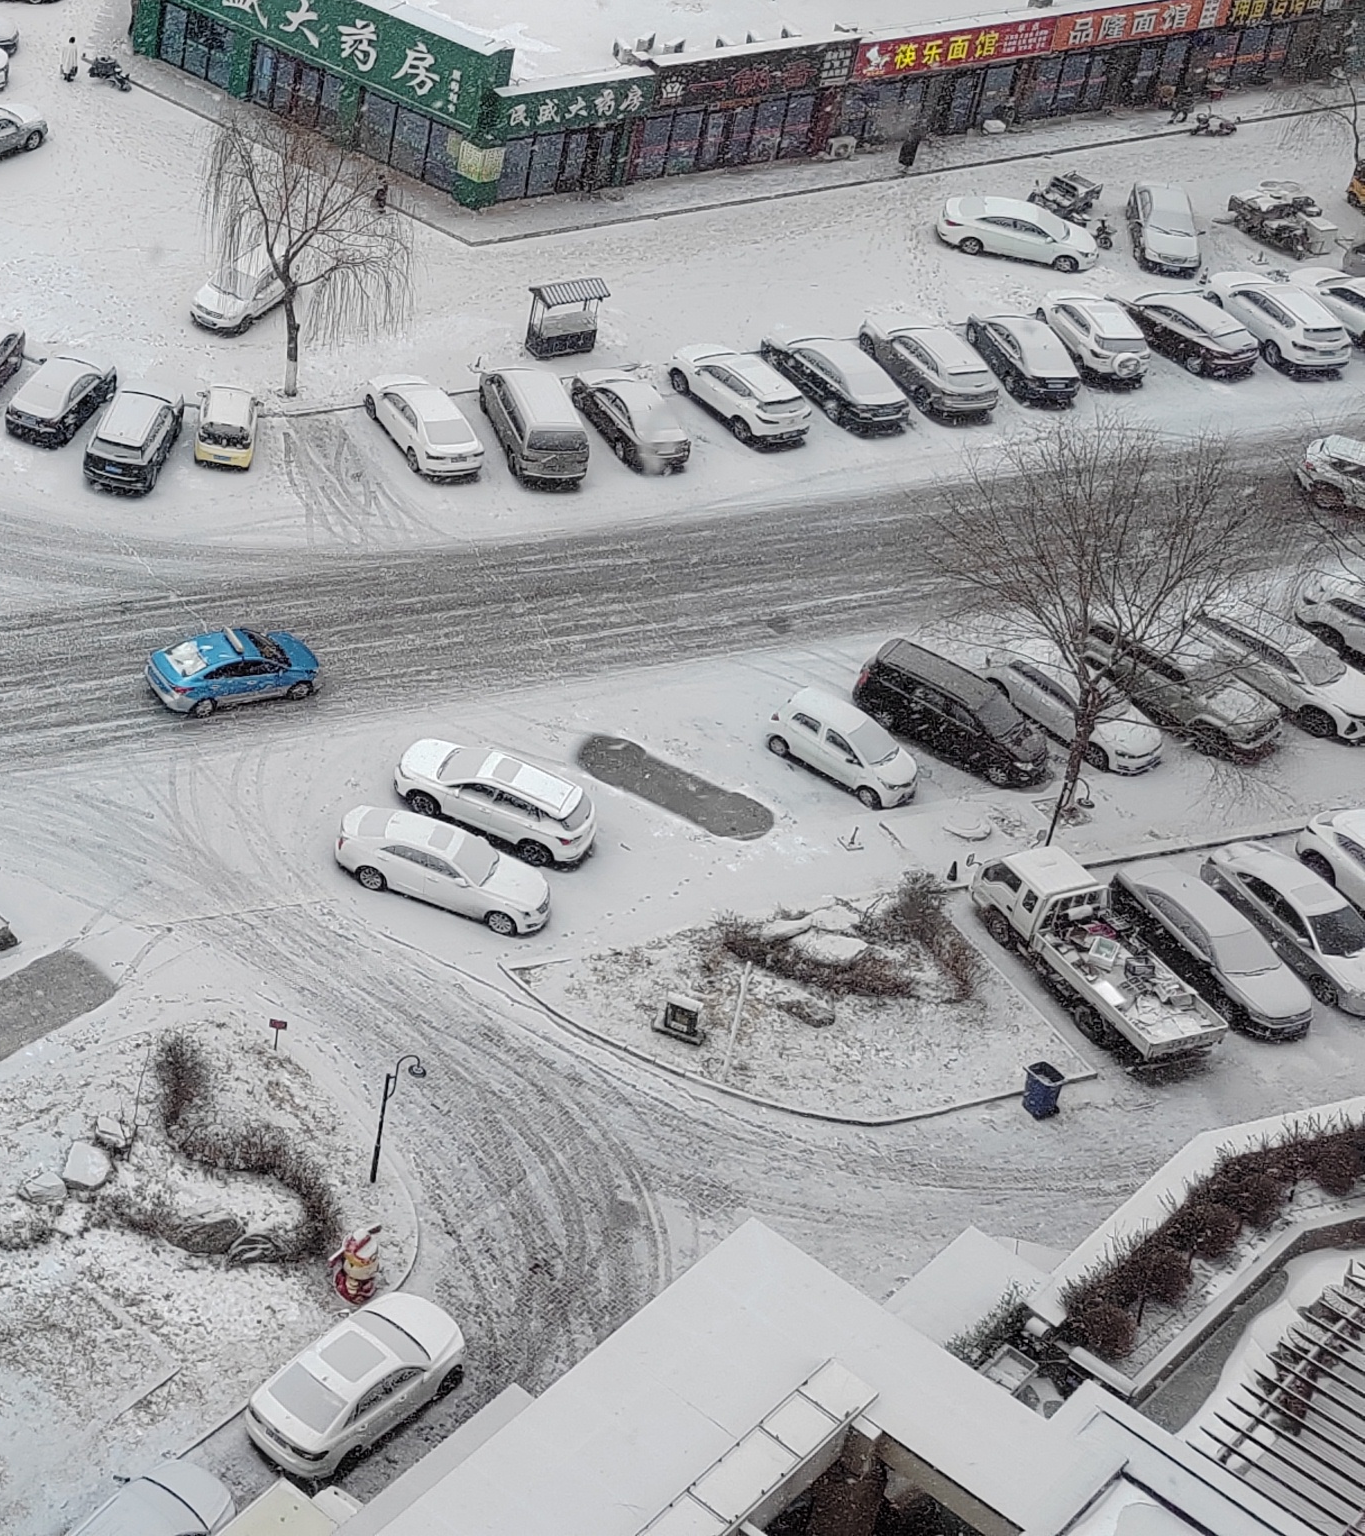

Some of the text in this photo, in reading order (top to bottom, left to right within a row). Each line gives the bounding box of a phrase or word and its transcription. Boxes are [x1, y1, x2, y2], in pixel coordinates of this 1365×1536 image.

[1069, 3, 1191, 44] 品隆面馆
[894, 30, 999, 69] 筷乐面馆
[508, 85, 645, 127] 民盛大药房
